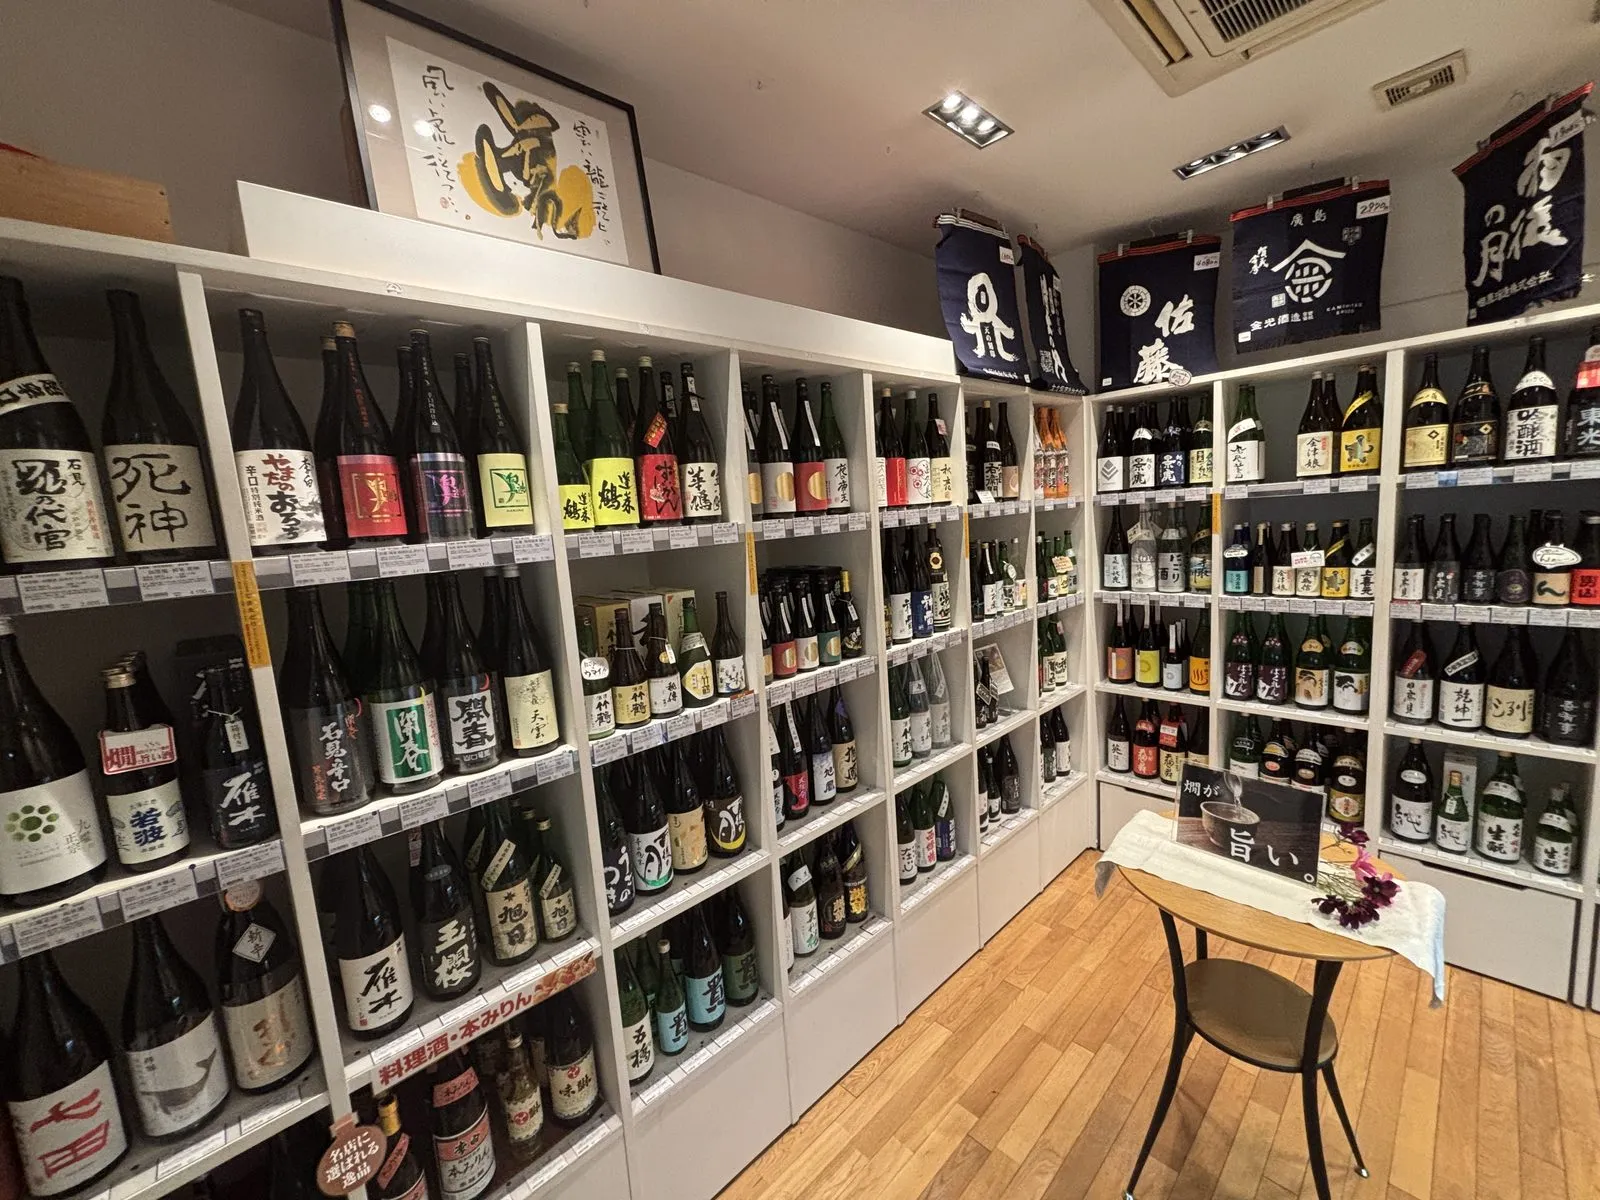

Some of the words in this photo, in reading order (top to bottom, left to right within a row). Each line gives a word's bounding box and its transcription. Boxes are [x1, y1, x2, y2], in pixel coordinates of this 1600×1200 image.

[113, 454, 191, 543] 死神
[451, 695, 495, 750] 開春
[319, 721, 350, 793] 石見辛口
[219, 771, 266, 826] 雁木
[1184, 779, 1220, 798] 燗が
[130, 808, 166, 847] 若波
[361, 957, 402, 1015] 雁木
[379, 993, 533, 1086] 料理酒・本みりん
[325, 1141, 380, 1184] 選ばれる
[330, 1131, 371, 1163] 名店に
[341, 1164, 372, 1189] 逸品
